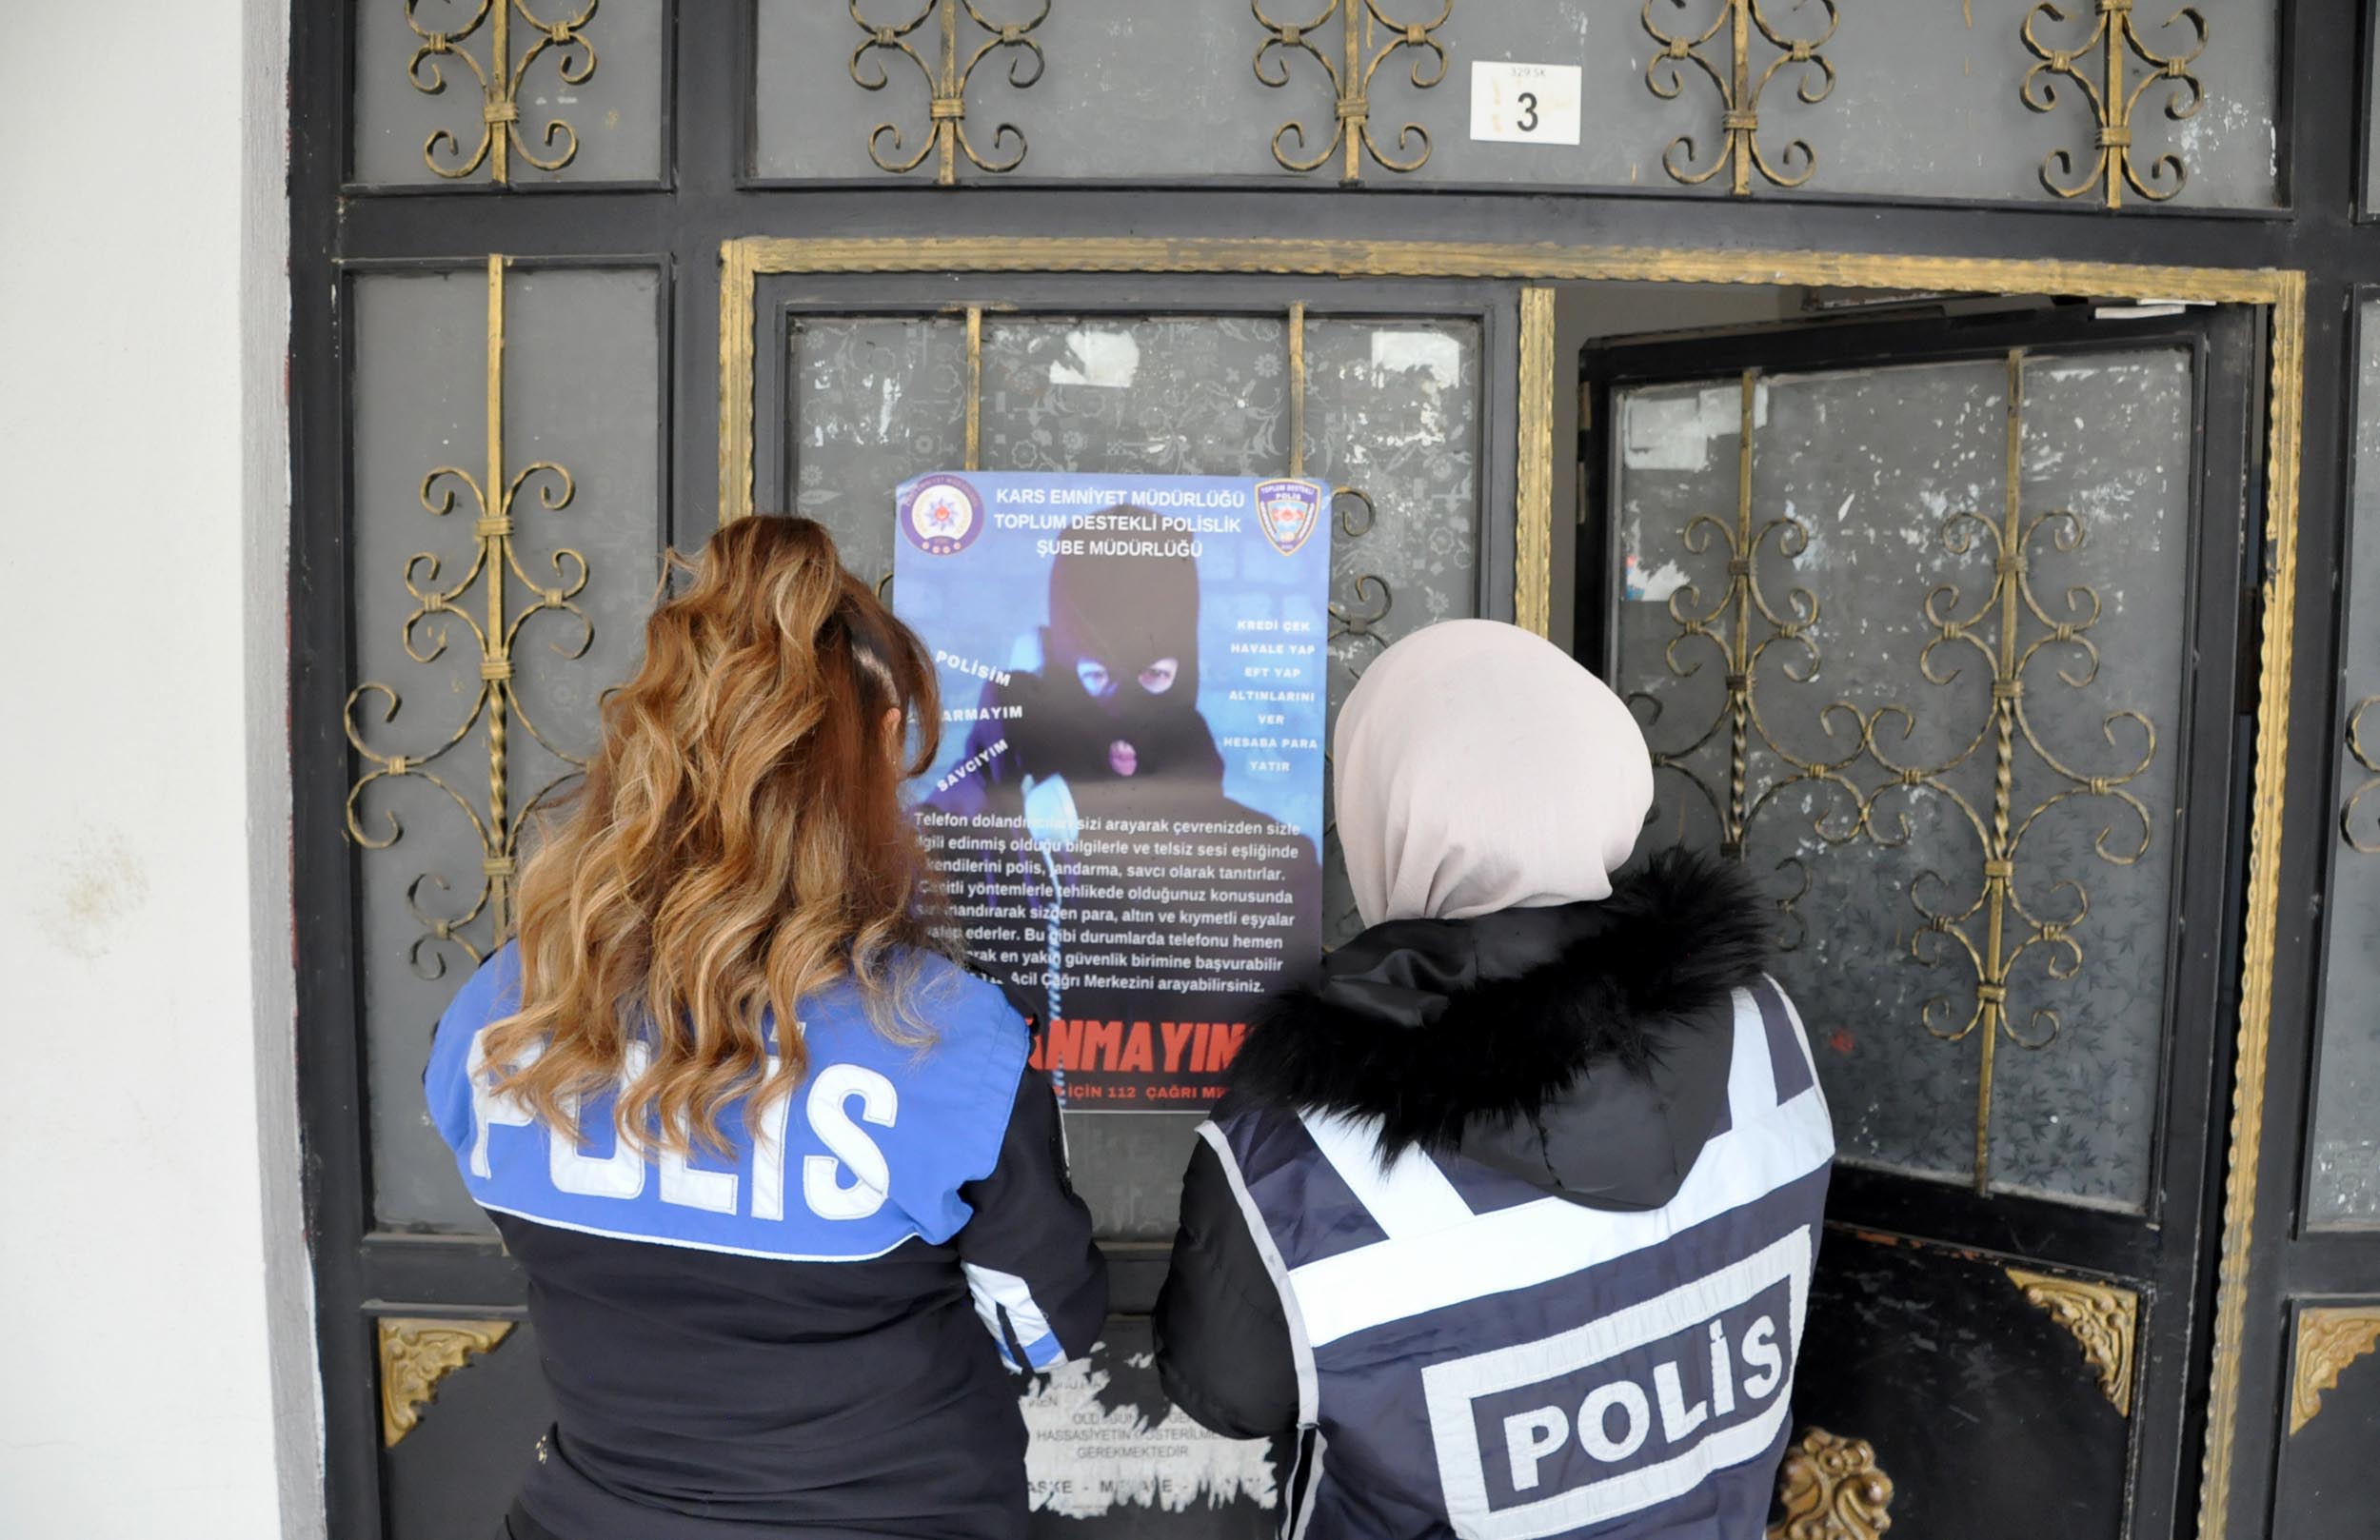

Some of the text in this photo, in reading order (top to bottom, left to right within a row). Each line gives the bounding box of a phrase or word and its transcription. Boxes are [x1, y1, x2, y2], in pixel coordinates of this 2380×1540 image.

[1517, 91, 1538, 132] 3
[997, 488, 1046, 504] KARS
[1050, 486, 1127, 505] EMNİYET
[1132, 489, 1245, 508] MÜDÜRLÜĞÜ
[994, 513, 1067, 530] TOPLUM
[1071, 514, 1158, 532] DESTEKLİ
[1161, 515, 1242, 534] POLİSLİK
[1037, 539, 1203, 559] ŞUBE MÜDÜRLÜĞÜ
[1238, 620, 1310, 633] KREDİ ÇEK
[1231, 643, 1316, 655] HAVALE YAP
[935, 649, 1012, 687] POLİSİM
[1244, 667, 1301, 679] EFT YAP
[1229, 690, 1315, 701] ALTINLARINI
[1258, 715, 1285, 725] VER
[1223, 737, 1318, 749] HESABA PARA
[937, 739, 1009, 792] SAVCIYIM
[1250, 760, 1291, 772] YATIR
[914, 812, 968, 827] Telefon
[1079, 817, 1101, 831] sizi
[1105, 819, 1170, 835] arayarak
[1173, 820, 1263, 836] çevrenizden
[1266, 821, 1301, 837] sizle
[948, 837, 1006, 854] edinmiş
[1010, 839, 1061, 853] olduğu
[1065, 839, 1129, 857] bilgilerle
[1133, 843, 1150, 855] ve
[1154, 842, 1193, 856] telsiz
[1198, 843, 1228, 858] sesi
[1232, 844, 1299, 861] eşliğinde
[927, 858, 1286, 881] kendilerini polis, andarma, savcı olarak tanıtırlar.
[967, 882, 1054, 899] yöntemlerle
[1128, 887, 1207, 904] olduğunuz
[1210, 889, 1294, 904] konusunda
[1081, 910, 1119, 925] para,
[1121, 908, 1155, 923] altın
[1158, 912, 1176, 923] ve
[1180, 911, 1238, 928] kıymetli
[1241, 914, 1296, 929] eşyalar
[965, 927, 1021, 941] ederler.
[1024, 928, 1045, 942] Bu
[1080, 930, 1165, 945] durumlarda
[1168, 934, 1229, 948] telefonu
[1233, 935, 1284, 949] hemen
[1001, 953, 1019, 963] en
[1065, 953, 1128, 968] güvenlik
[1131, 954, 1191, 968] birimine
[1195, 956, 1283, 972] başvurabilir
[1011, 972, 1038, 986] Acil
[1084, 976, 1154, 990] Merkezini
[1158, 977, 1265, 994] arayabilirsiniz.
[1068, 1083, 1102, 1099] İÇİN
[1108, 1086, 1137, 1098] 112
[1145, 1084, 1198, 1100] ÇAĞRI
[1503, 1314, 1784, 1491] POLİS
